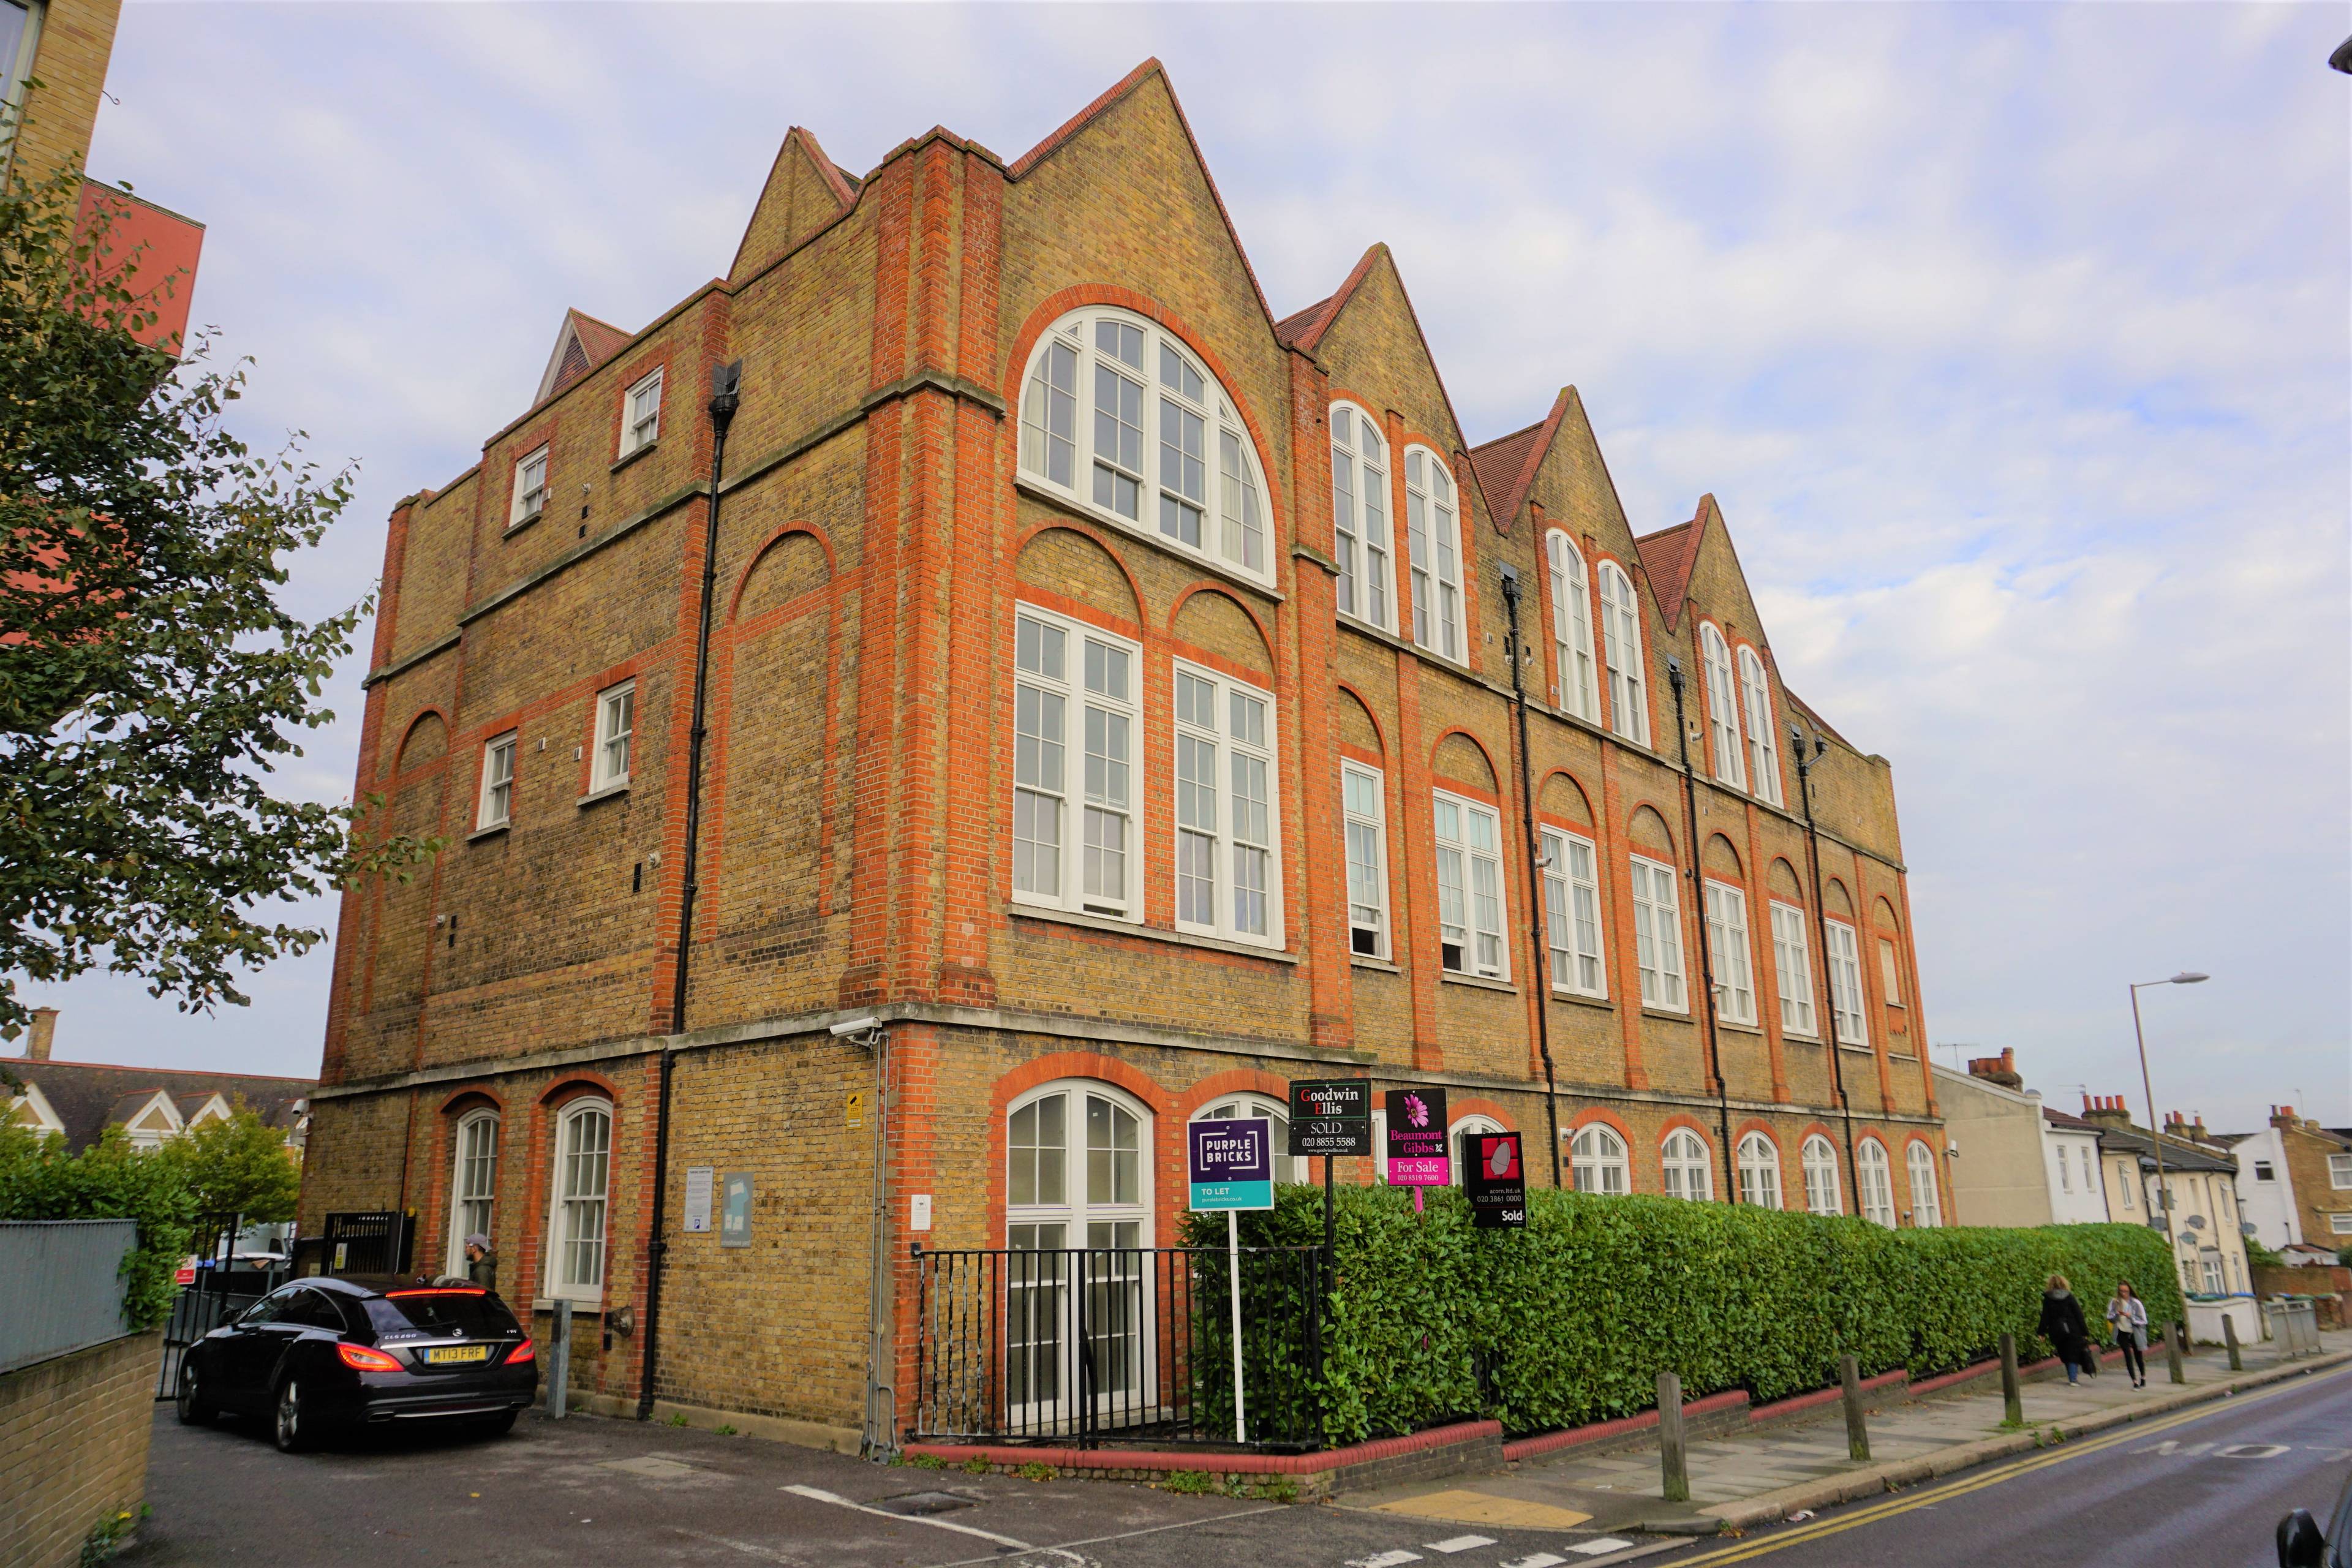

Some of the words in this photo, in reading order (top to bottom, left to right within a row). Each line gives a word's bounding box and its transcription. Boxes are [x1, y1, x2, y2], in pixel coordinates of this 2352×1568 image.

[1300, 1088, 1359, 1102] Goodwin
[1314, 1102, 1343, 1115] Ellis
[1311, 1122, 1342, 1134] SOLD
[1390, 1129, 1442, 1140] Beaumont
[1206, 1139, 1251, 1151] PURPLE
[1302, 1137, 1315, 1147] 020
[1316, 1137, 1334, 1147] 8855
[1336, 1137, 1355, 1147] 5588
[1403, 1142, 1434, 1153] Gibbs
[1207, 1151, 1251, 1163] BRICKS
[1397, 1161, 1414, 1172] For
[1415, 1161, 1439, 1172] Sale
[1502, 1210, 1523, 1221] Sold
[434, 1349, 458, 1360] MT13
[461, 1348, 481, 1359] FRF
